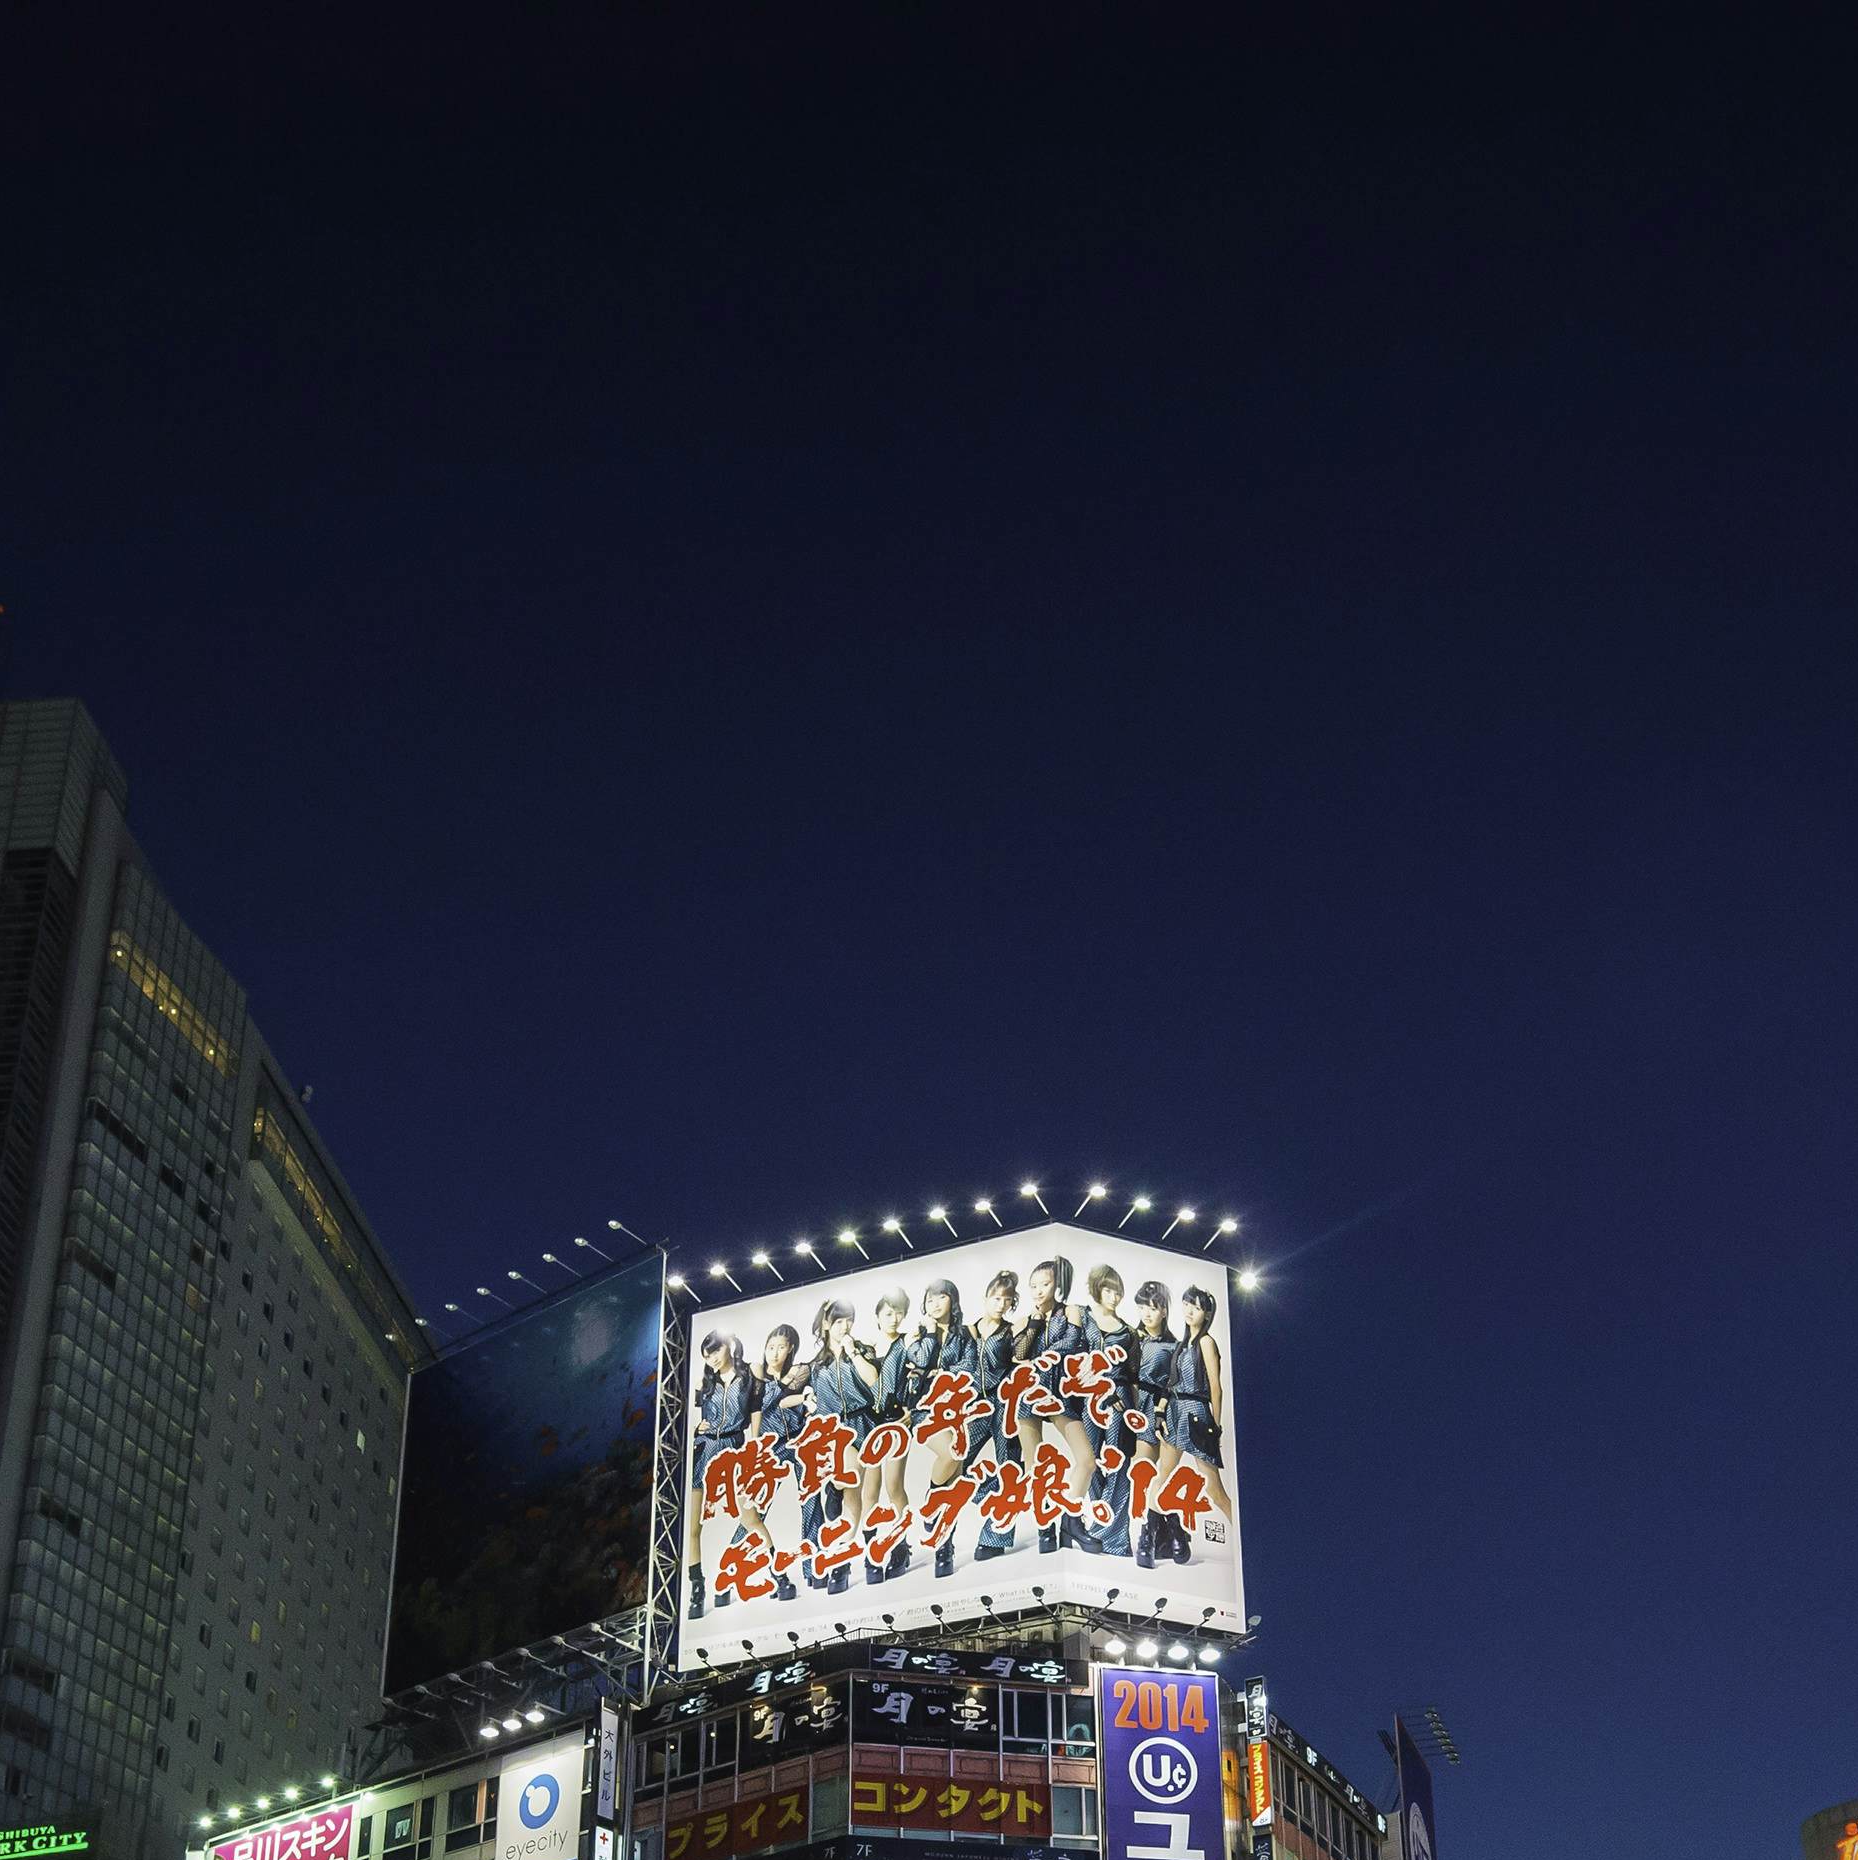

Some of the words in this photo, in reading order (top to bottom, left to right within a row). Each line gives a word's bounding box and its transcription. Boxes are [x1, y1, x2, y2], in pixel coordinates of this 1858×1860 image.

[702, 1346, 1149, 1525] 勝負の年だぞ。
[872, 1682, 889, 1694] 9F
[1114, 1679, 1210, 1734] 2014
[853, 1780, 1044, 1824] コンタクト
[31, 1831, 87, 1850] CITY
[667, 1793, 805, 1860] プライス
[855, 1843, 873, 1857] 7F
